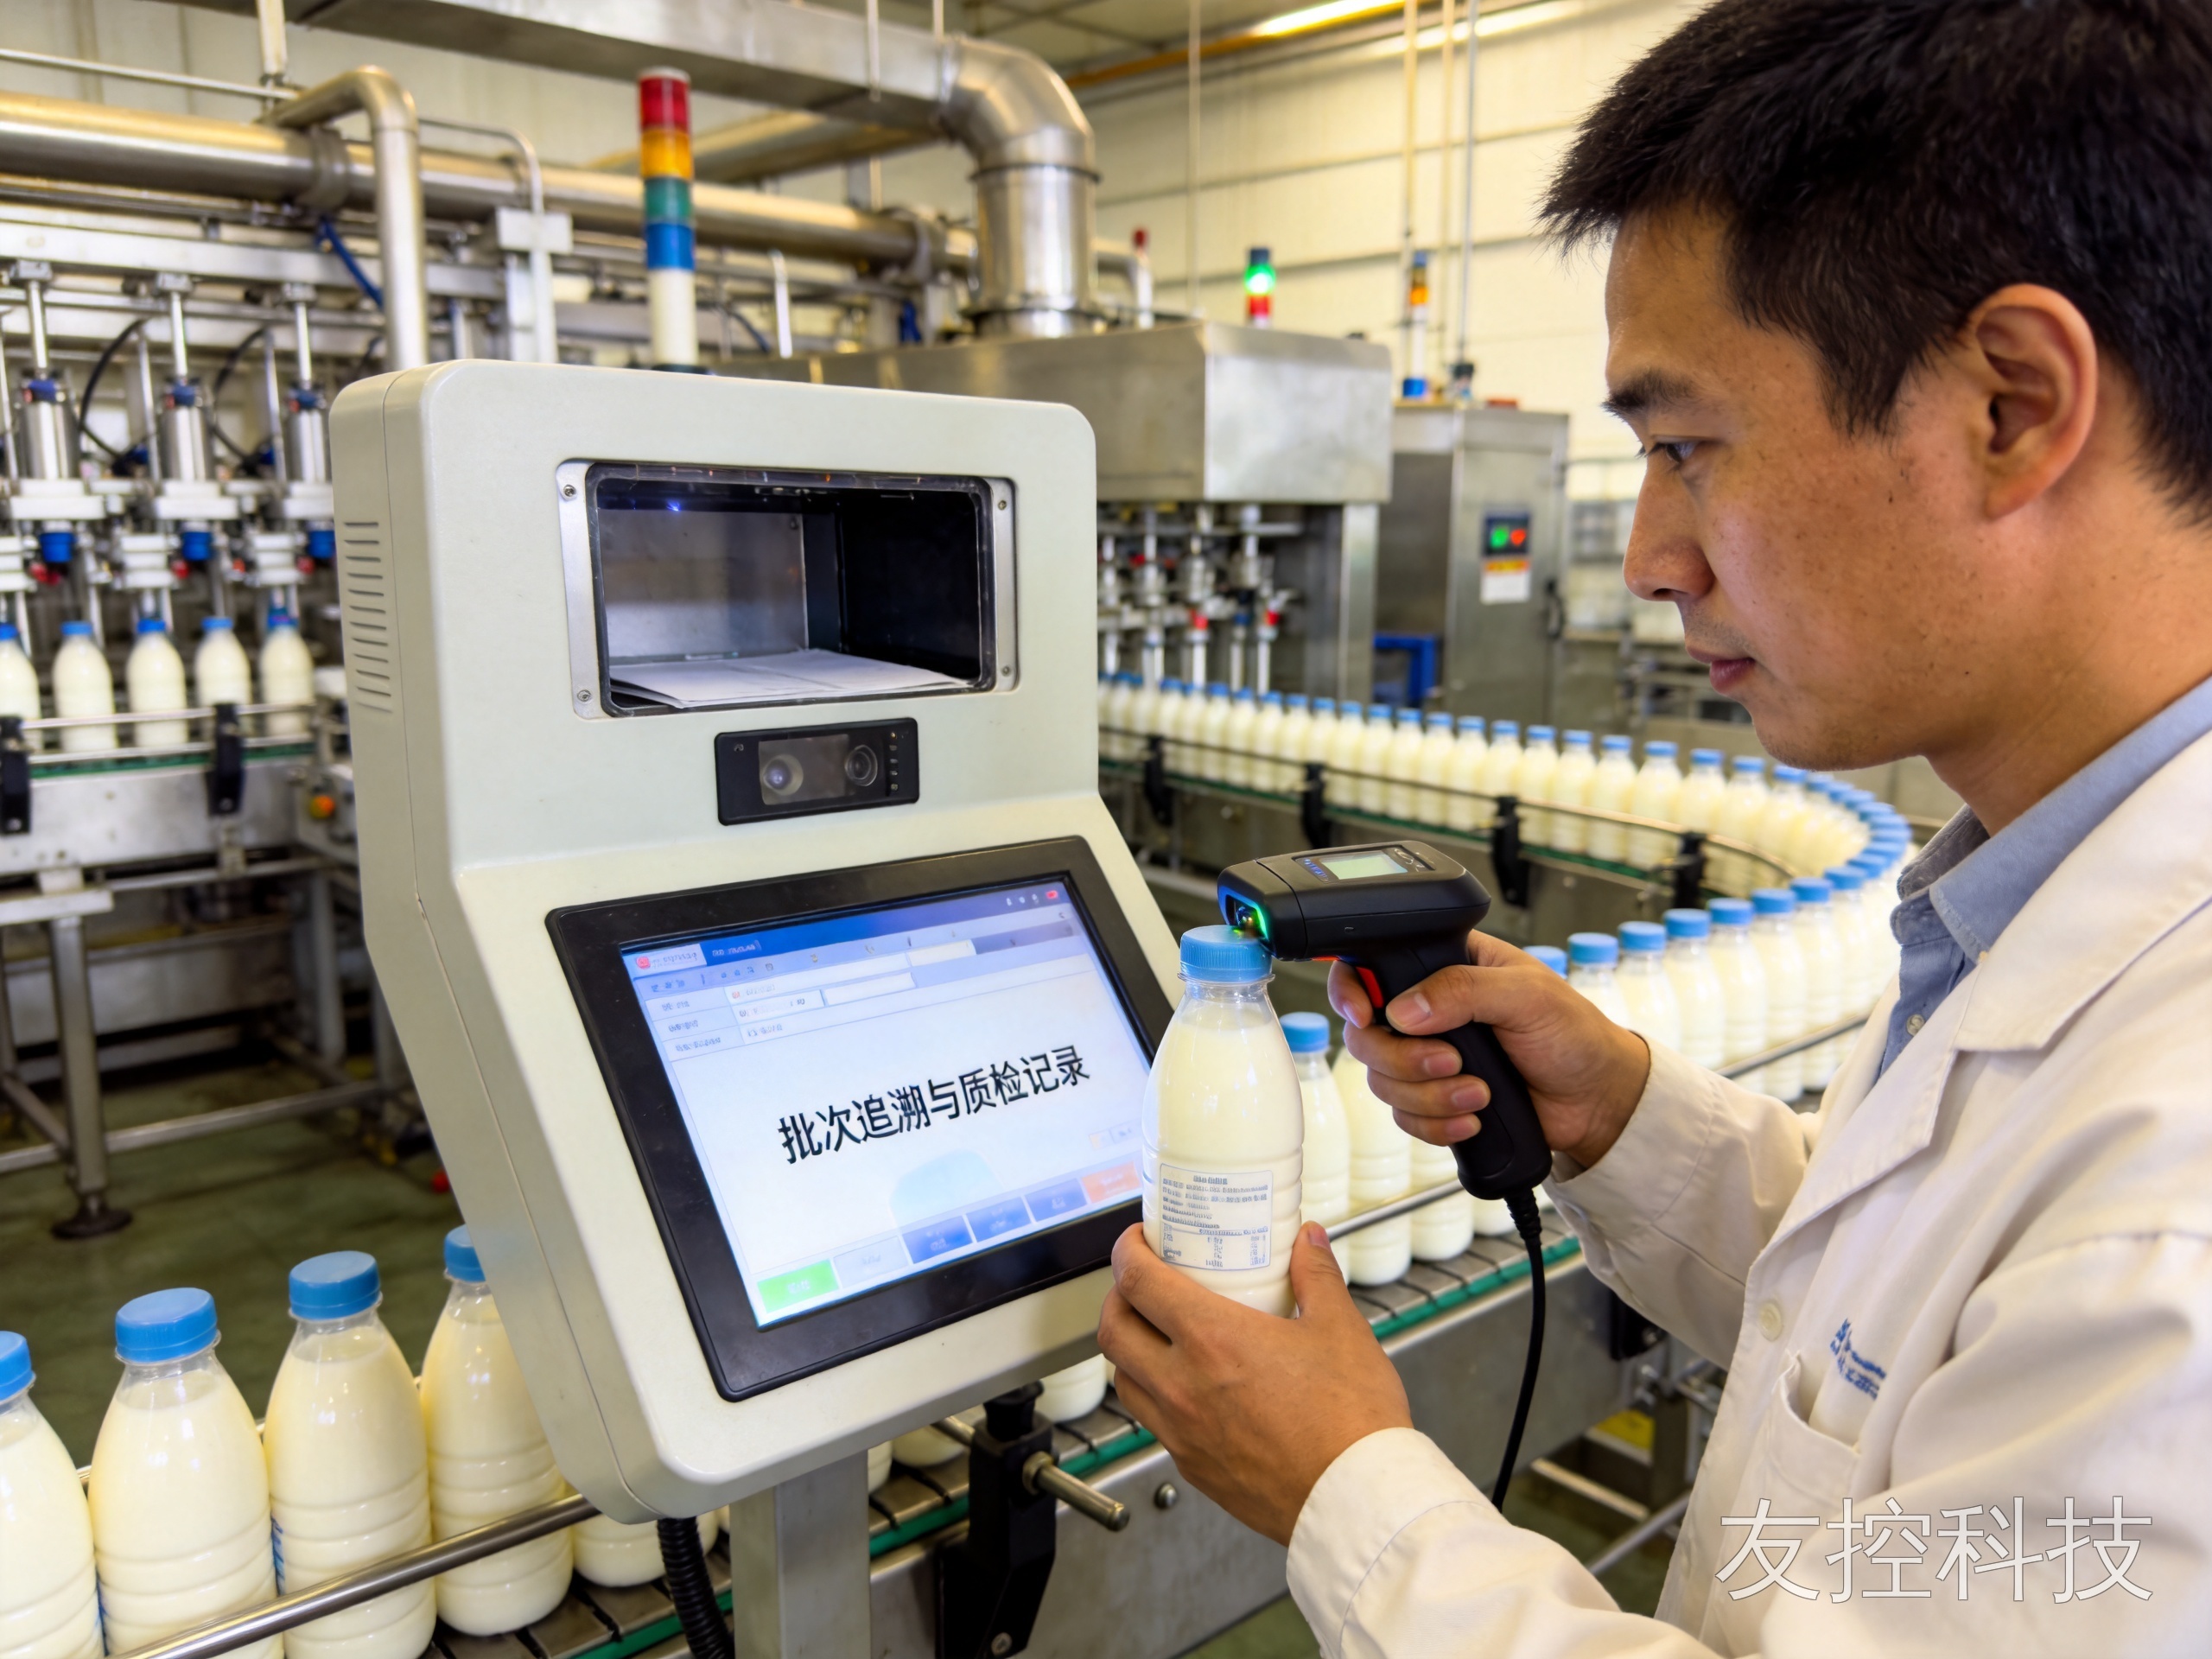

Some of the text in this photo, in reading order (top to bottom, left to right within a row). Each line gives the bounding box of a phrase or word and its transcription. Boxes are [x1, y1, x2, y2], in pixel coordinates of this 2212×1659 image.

[778, 1045, 1090, 1165] 批次追溯与质检记录
